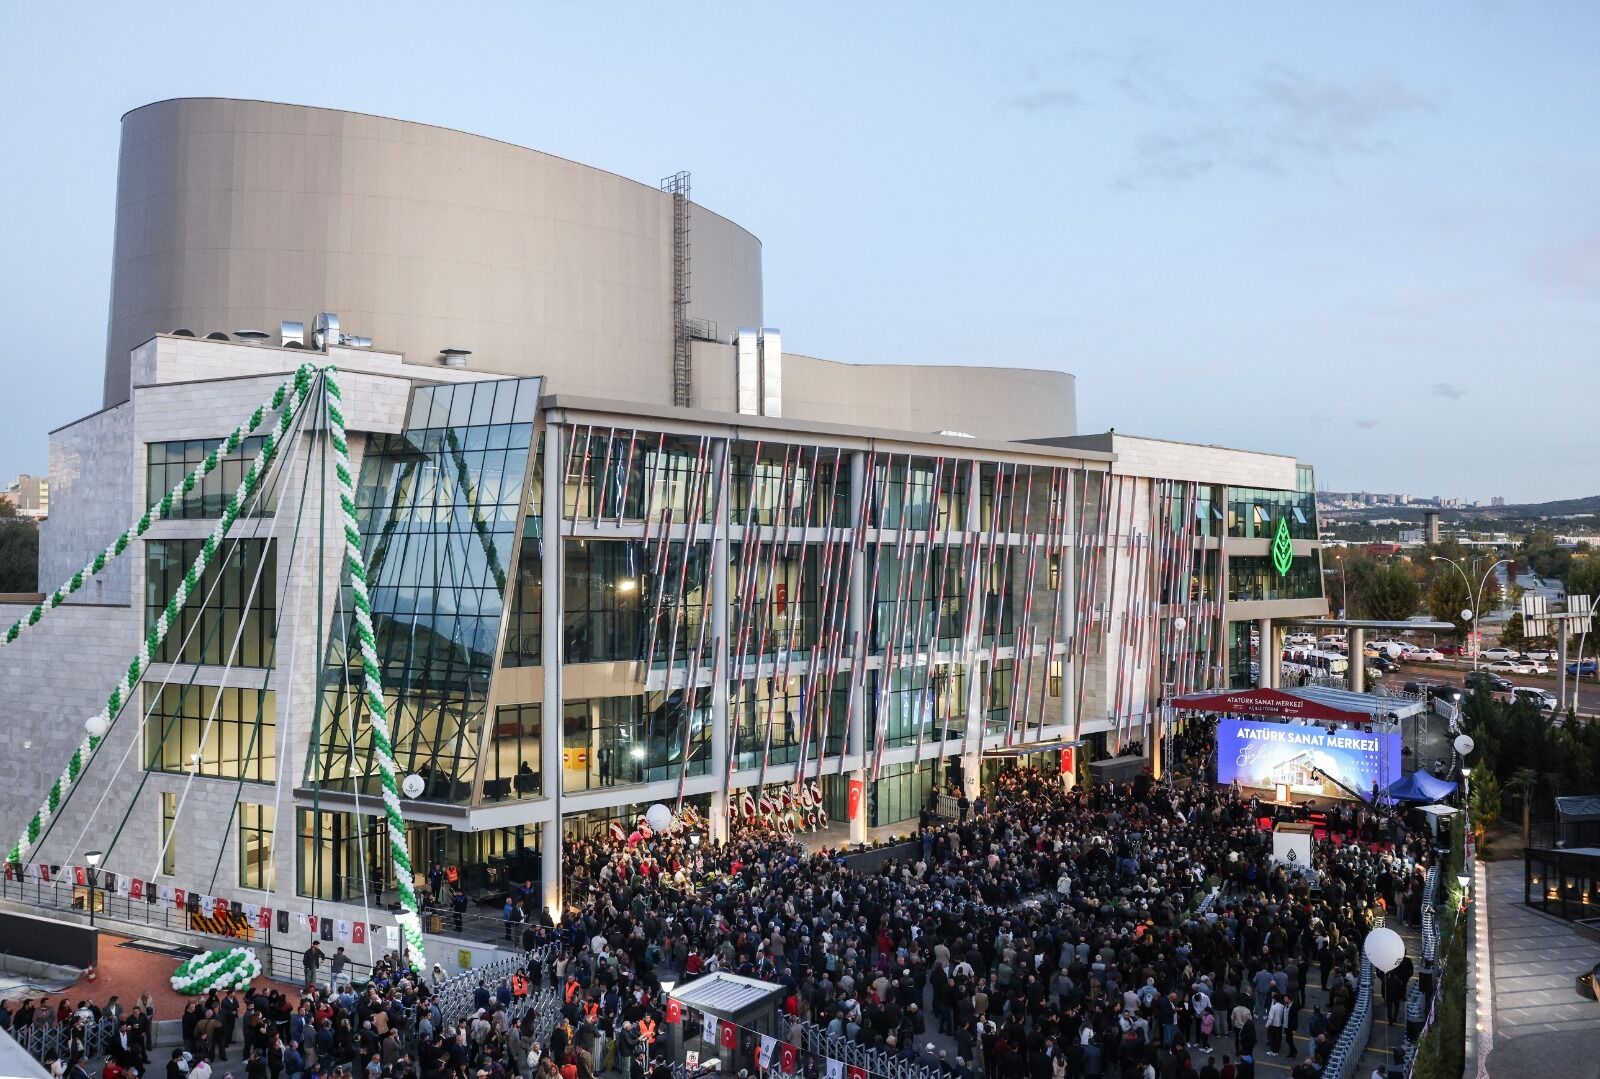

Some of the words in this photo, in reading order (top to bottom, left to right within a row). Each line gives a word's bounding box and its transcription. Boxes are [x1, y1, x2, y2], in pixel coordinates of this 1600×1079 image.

[1255, 698, 1274, 706] SANAT
[1276, 700, 1304, 708] MERKEZİ
[1237, 728, 1286, 741] ATATÜRK
[1288, 733, 1324, 745] SANAT
[1327, 737, 1379, 751] MERKEZİ
